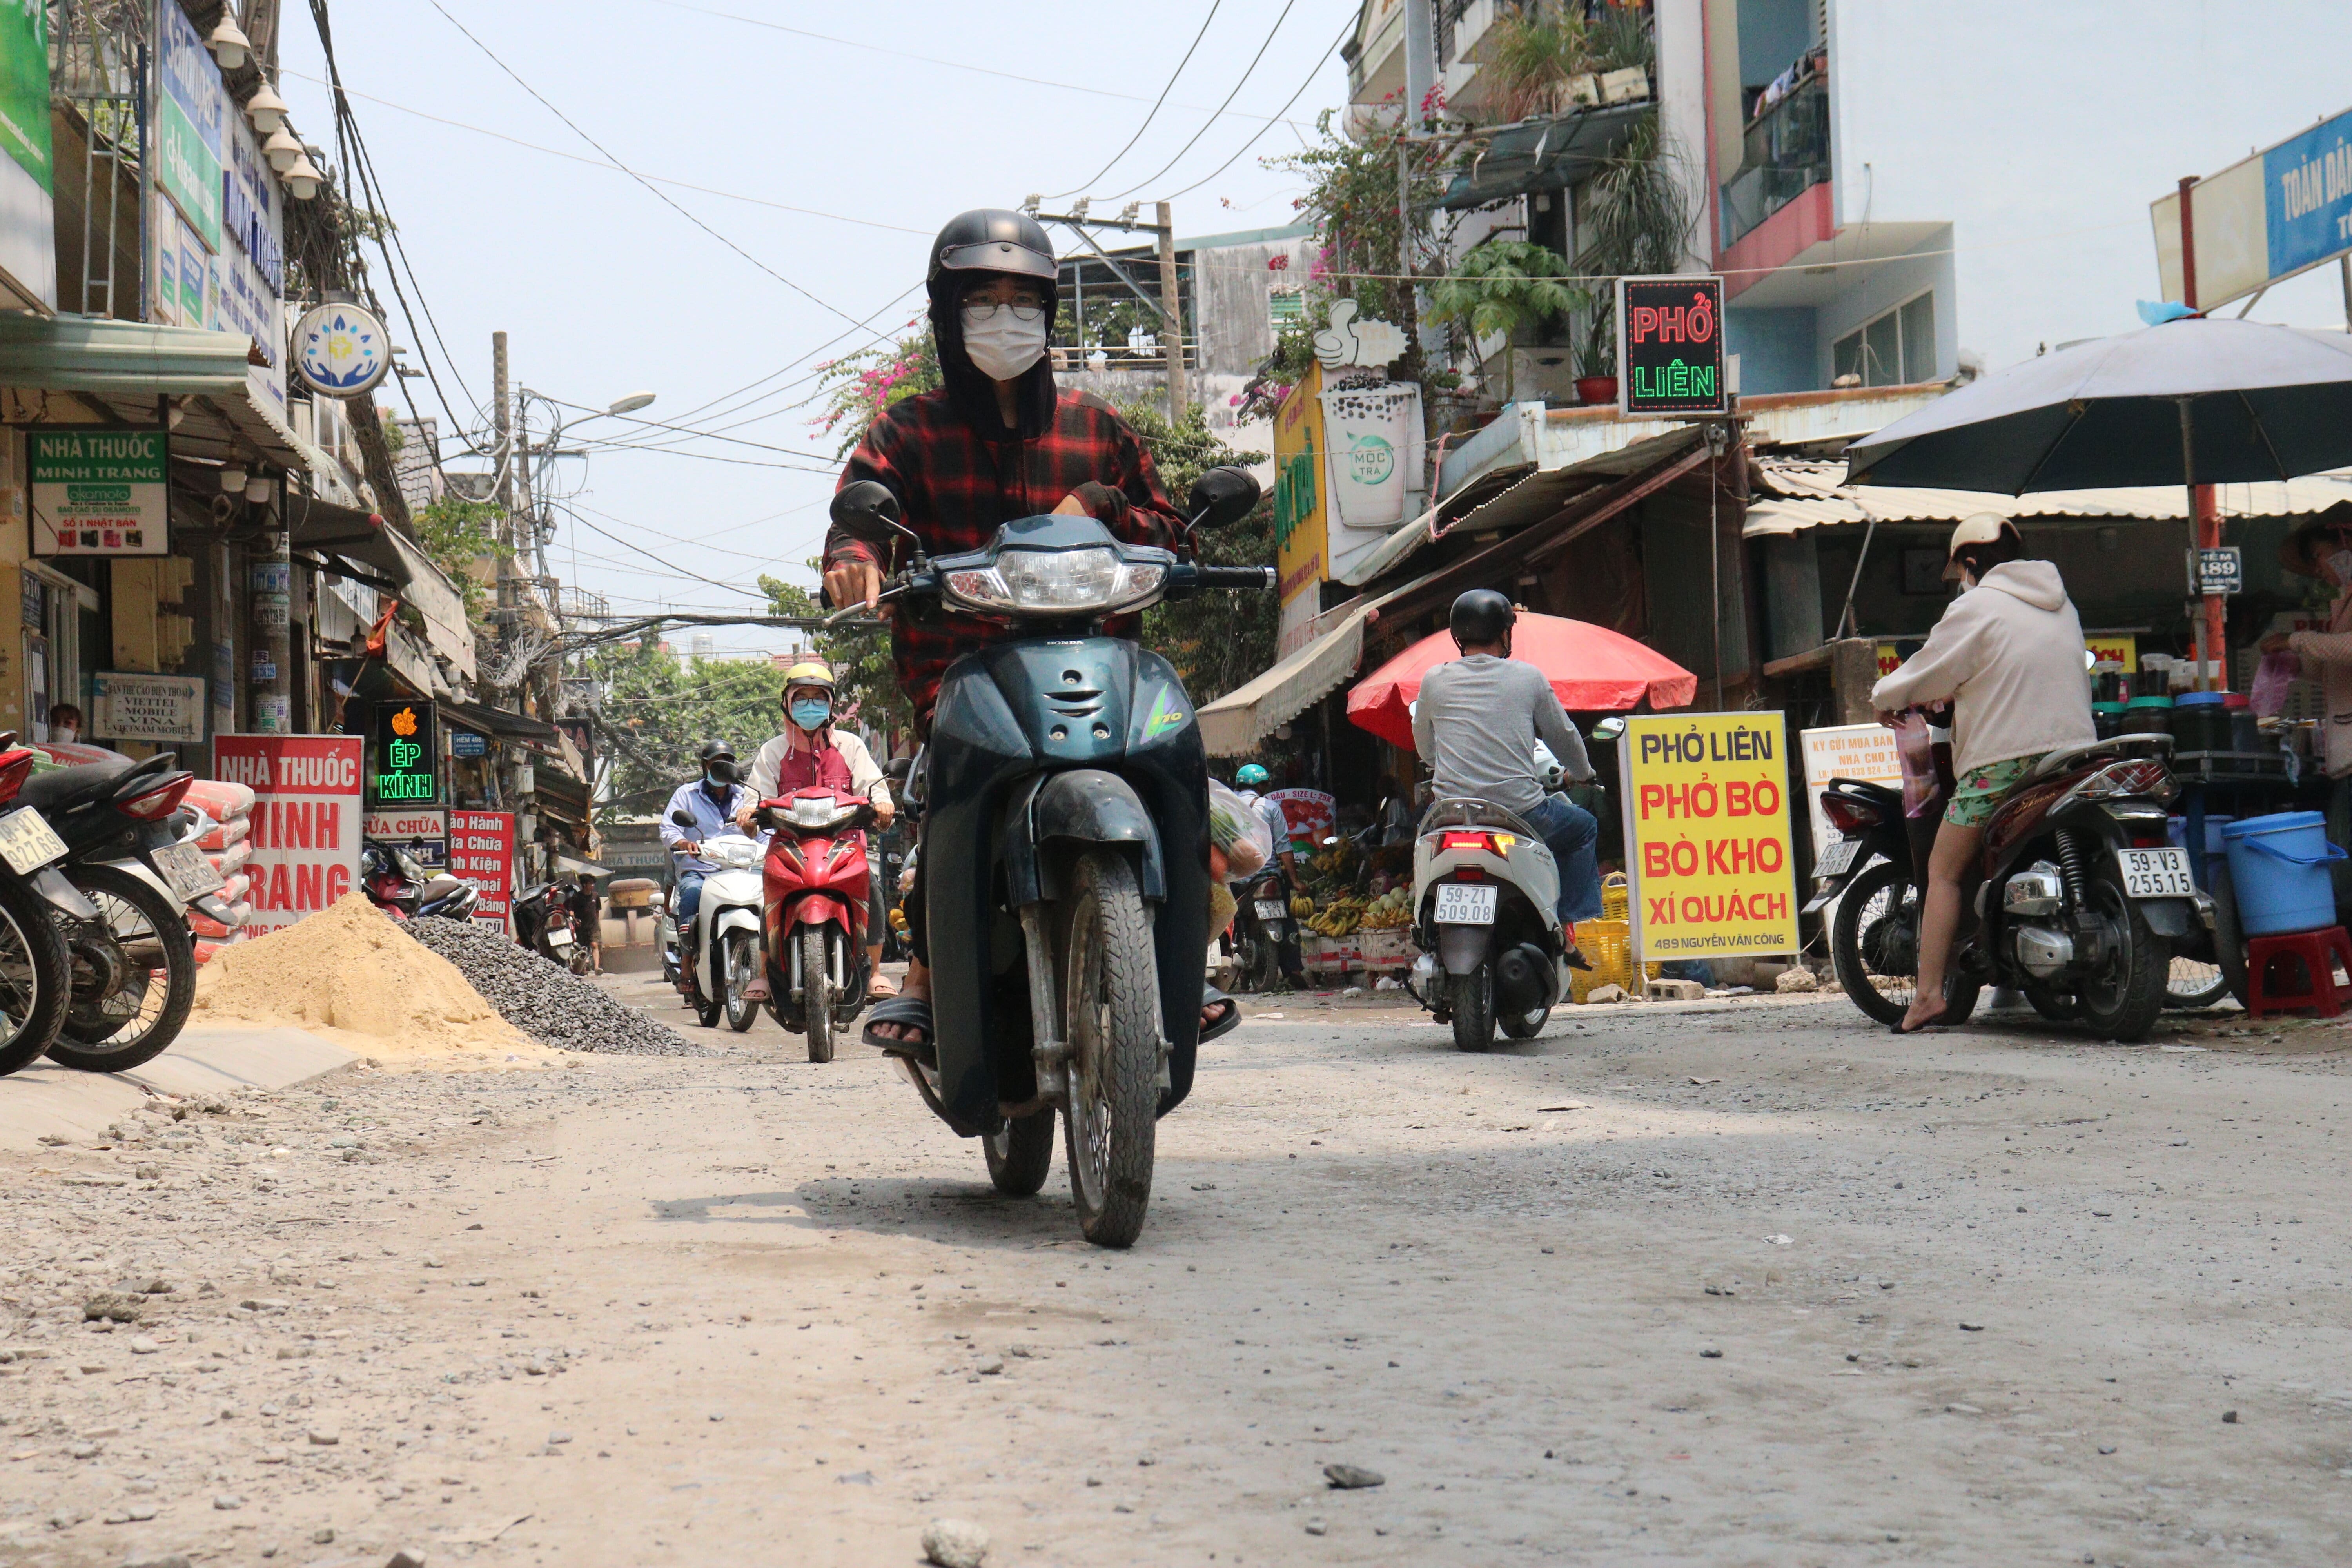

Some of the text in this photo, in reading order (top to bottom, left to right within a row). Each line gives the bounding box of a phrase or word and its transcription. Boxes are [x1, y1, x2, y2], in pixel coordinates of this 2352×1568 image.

[2281, 154, 2323, 221] TOÁN
[1633, 292, 1713, 343] PHỞ
[1635, 358, 1715, 397] LIÊN
[40, 432, 83, 458] NHÀ
[36, 467, 160, 479] MINH TRANG
[125, 697, 178, 707] VIETTEL
[125, 707, 176, 716] MOBILE
[129, 716, 176, 725] VINA
[1152, 712, 1183, 726] 110
[390, 739, 421, 767] ÉP
[1641, 724, 1773, 764] PHỞ LIÊN
[1813, 738, 1825, 752] KÝ
[1848, 737, 1871, 749] MUA
[1873, 735, 1893, 747] BÁN
[221, 747, 356, 787] NHÀ THUỐC
[1838, 752, 1860, 766] NHÀ
[1865, 751, 1886, 764] CHO
[1867, 766, 1882, 775] 924
[379, 770, 432, 799] KÍNH
[1318, 793, 1332, 803] 25K
[1641, 772, 1780, 820] PHỞ BÒ
[245, 802, 340, 850] MINH
[396, 815, 441, 834] CHỮA
[450, 813, 503, 831] ảo Hành
[7, 832, 62, 869] 927.69
[468, 835, 502, 851] Chữa
[451, 856, 501, 874] nh Kiện
[1644, 833, 1783, 878] BÒ KHO
[2129, 852, 2179, 872] 59-V3
[241, 864, 350, 912] RANG
[2129, 873, 2190, 894] 255.15
[1446, 887, 1487, 904] 59-Z1
[479, 897, 506, 914] Bảng
[1438, 904, 1491, 921] 509.08
[1648, 888, 1788, 925] XÍ QUÁCH
[1654, 933, 1785, 950] 489 NGUYỄN VĂN CÔNG
